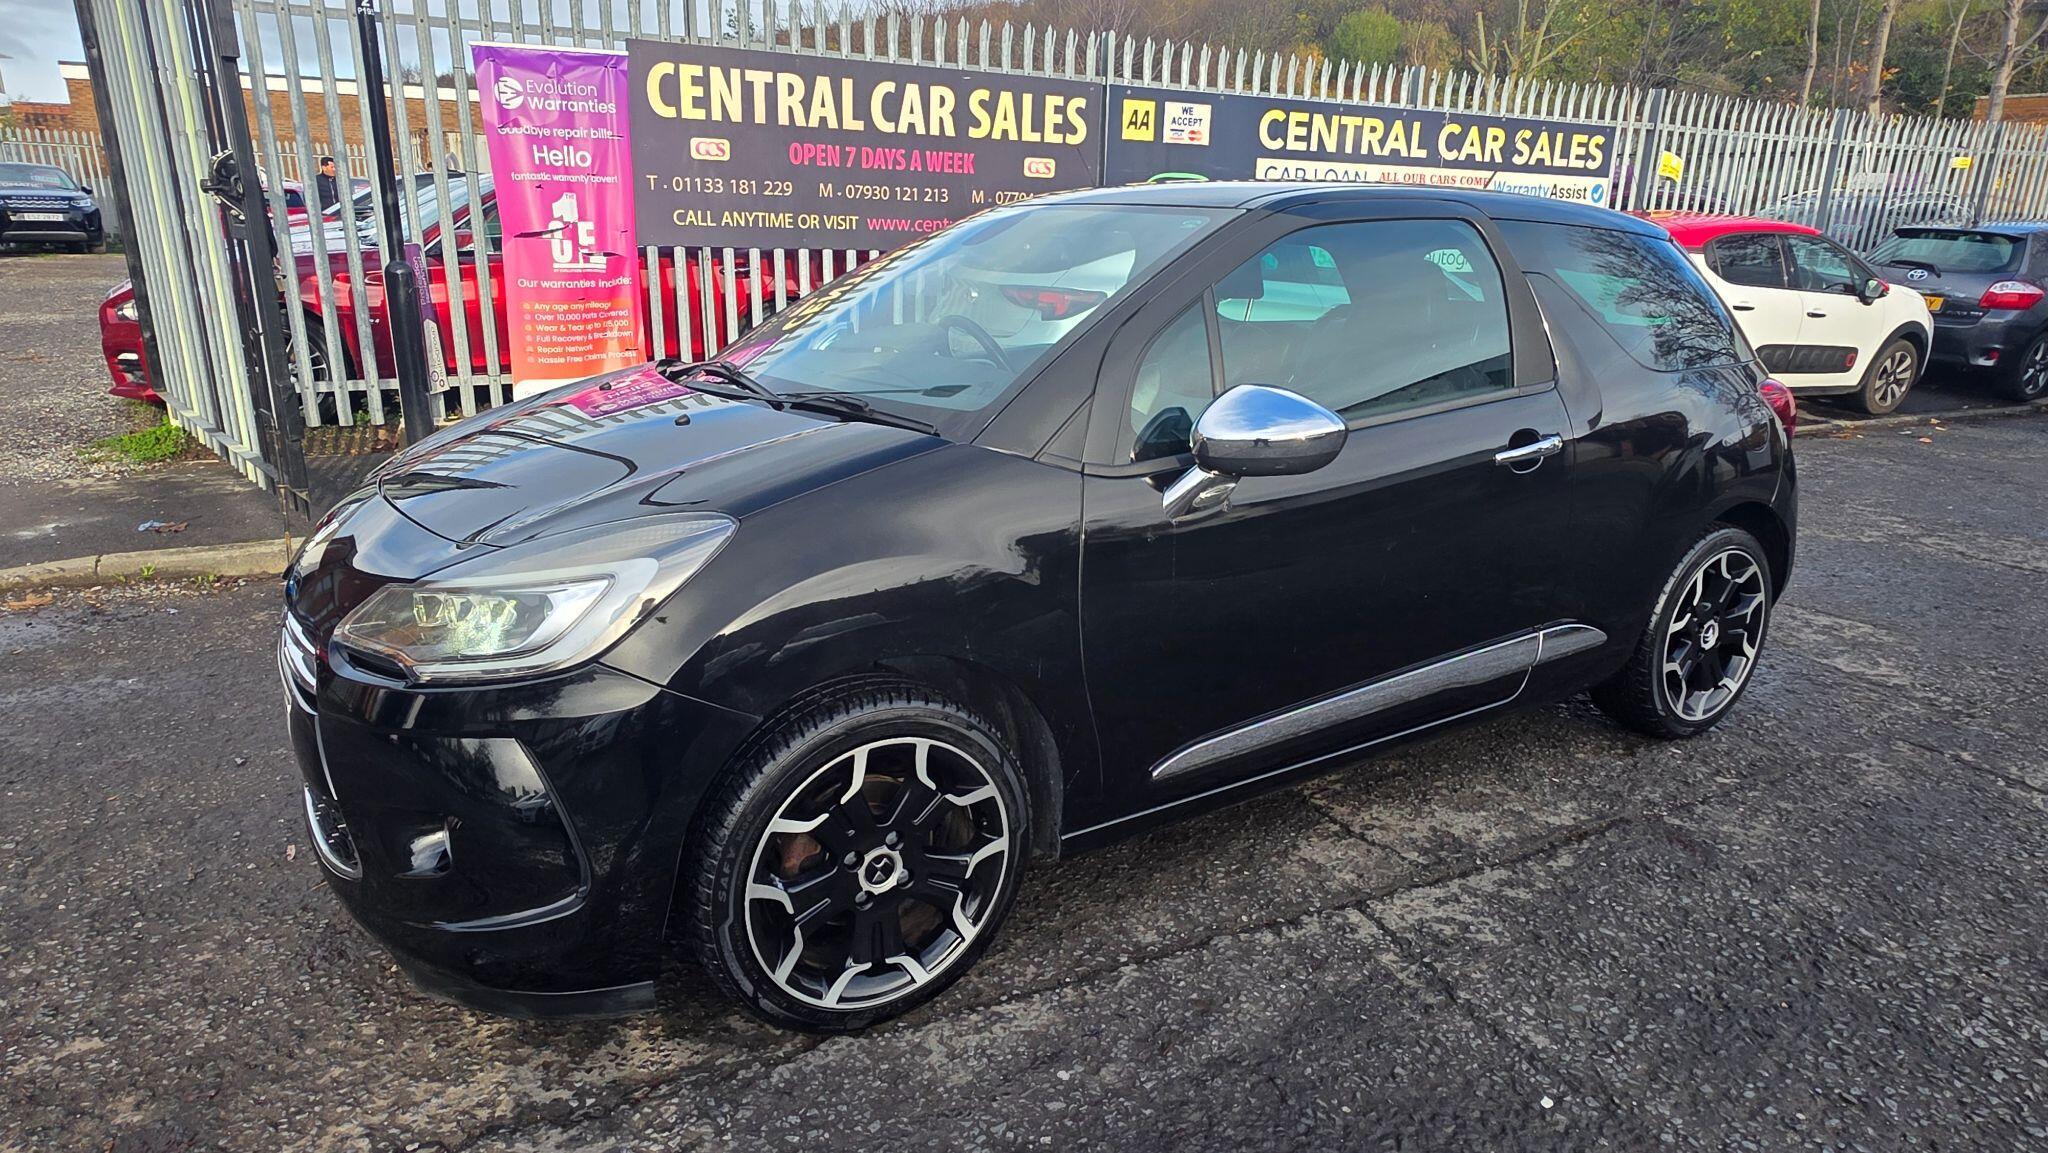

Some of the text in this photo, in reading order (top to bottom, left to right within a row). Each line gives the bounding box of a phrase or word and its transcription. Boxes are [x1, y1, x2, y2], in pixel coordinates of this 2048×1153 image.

[526, 80, 598, 97] Evolution
[527, 96, 617, 114] Warranties
[646, 62, 1088, 145] CENTRAL CAR SALES
[1181, 106, 1194, 116] WE
[1126, 109, 1150, 131] AA
[1170, 116, 1203, 127] ACCEPT
[553, 127, 588, 140] repair
[1259, 110, 1606, 171] CENTRAL CAR SALES
[533, 145, 592, 168] Hello
[789, 142, 976, 175] OPEN 7 DAYS A WEEK
[511, 171, 552, 182] fantastic
[553, 172, 589, 184] warranty
[1379, 171, 1399, 182] ALL
[1403, 173, 1426, 184] OUR
[1429, 174, 1457, 185] CARS
[672, 176, 724, 195] 01133
[730, 178, 758, 195] 181
[764, 179, 793, 197] 229
[845, 184, 890, 202] 07930
[894, 186, 919, 202] 121
[924, 187, 950, 204] 213
[673, 209, 717, 227] CALL
[721, 211, 794, 230] ANYTIME
[798, 213, 820, 231] OR
[824, 215, 859, 232] VISIT
[517, 279, 538, 288] Our
[541, 279, 596, 288] warranties
[534, 303, 550, 312] Any
[552, 303, 568, 312] age
[570, 302, 584, 311] any
[535, 313, 554, 321] Over
[556, 313, 580, 322] 10,000
[536, 324, 558, 332] Wear
[568, 323, 585, 331] Tear
[586, 323, 594, 331] up
[536, 335, 551, 343] Full
[552, 333, 587, 343] Recovery
[537, 346, 564, 354] Repair
[538, 356, 565, 365] Hassle
[567, 354, 583, 362] Free
